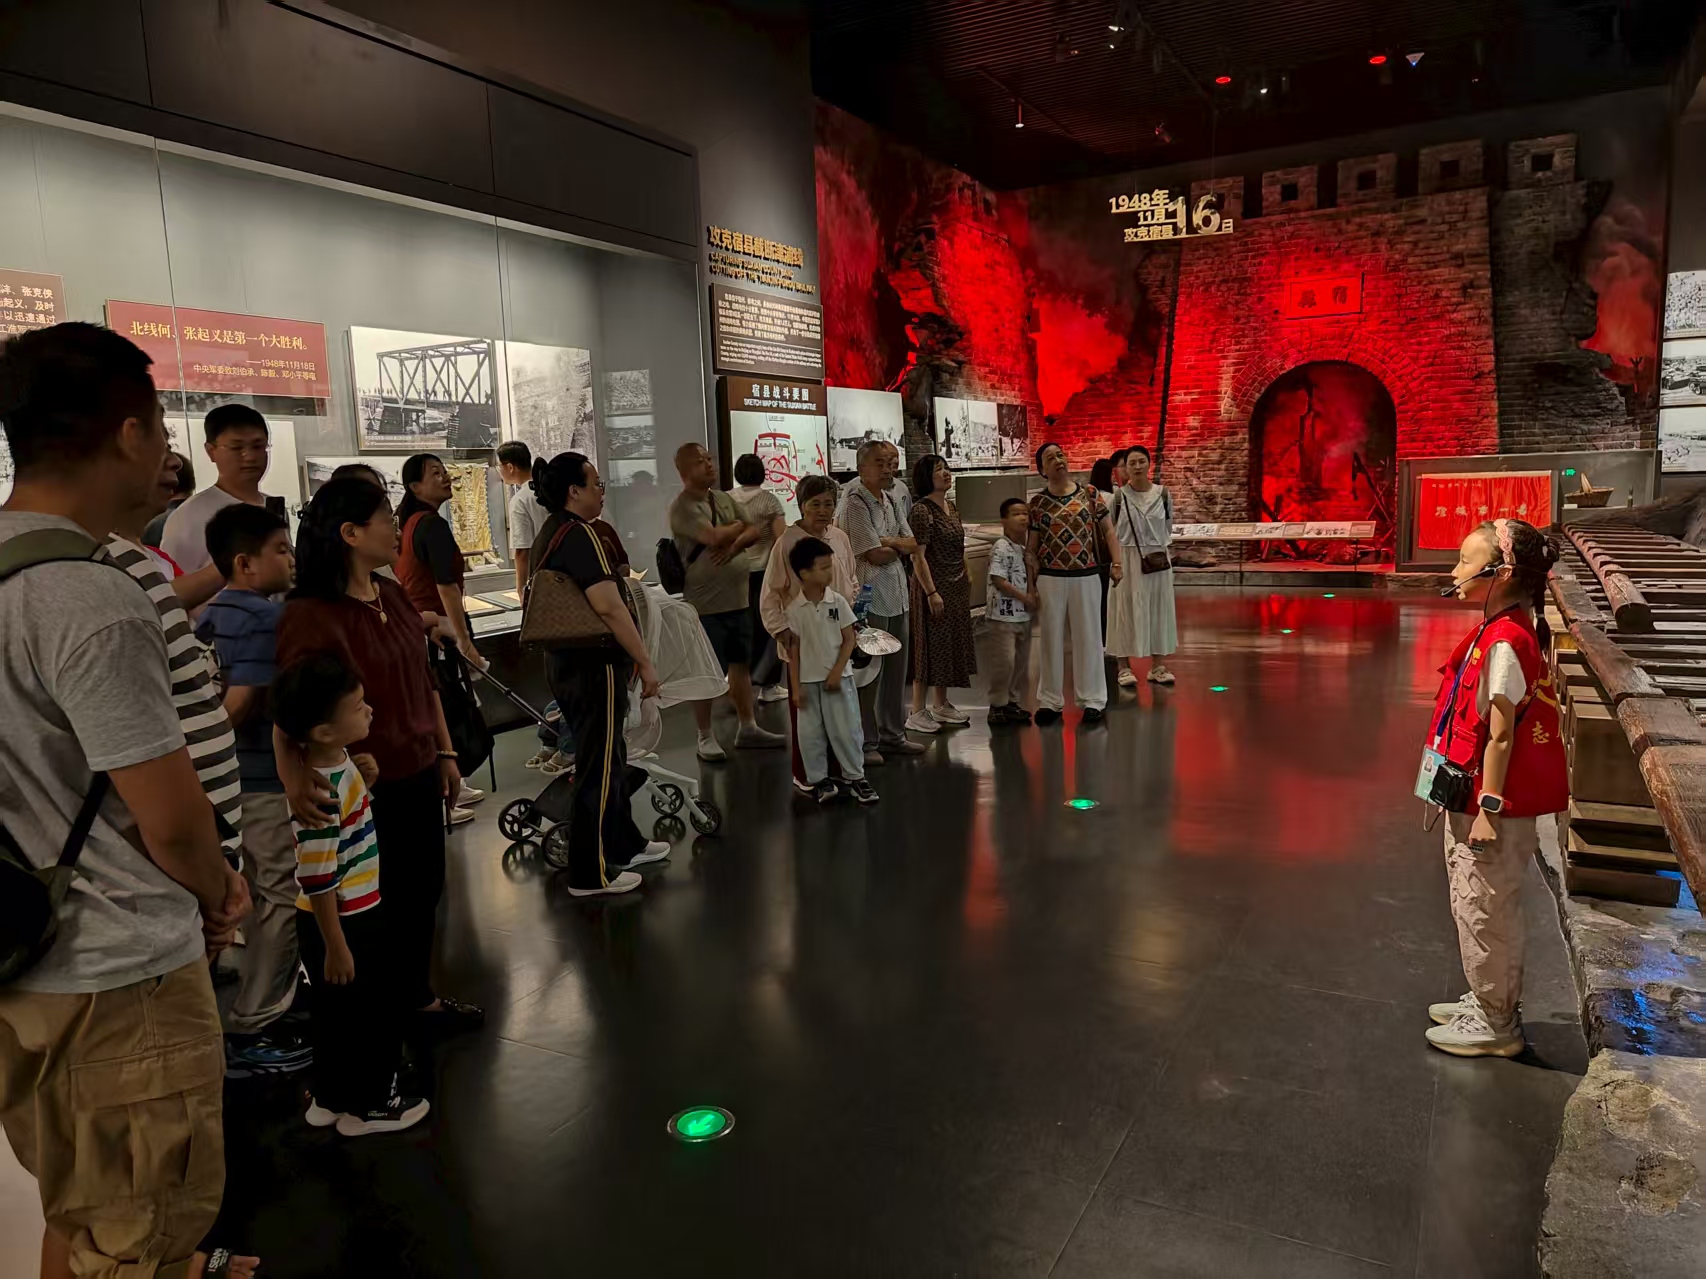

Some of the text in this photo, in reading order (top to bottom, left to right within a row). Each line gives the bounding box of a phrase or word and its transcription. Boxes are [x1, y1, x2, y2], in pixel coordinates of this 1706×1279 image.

[1109, 189, 1170, 213] 1948年
[1124, 224, 1174, 240] 攻克宿县
[0, 310, 56, 325] 以迅速通过
